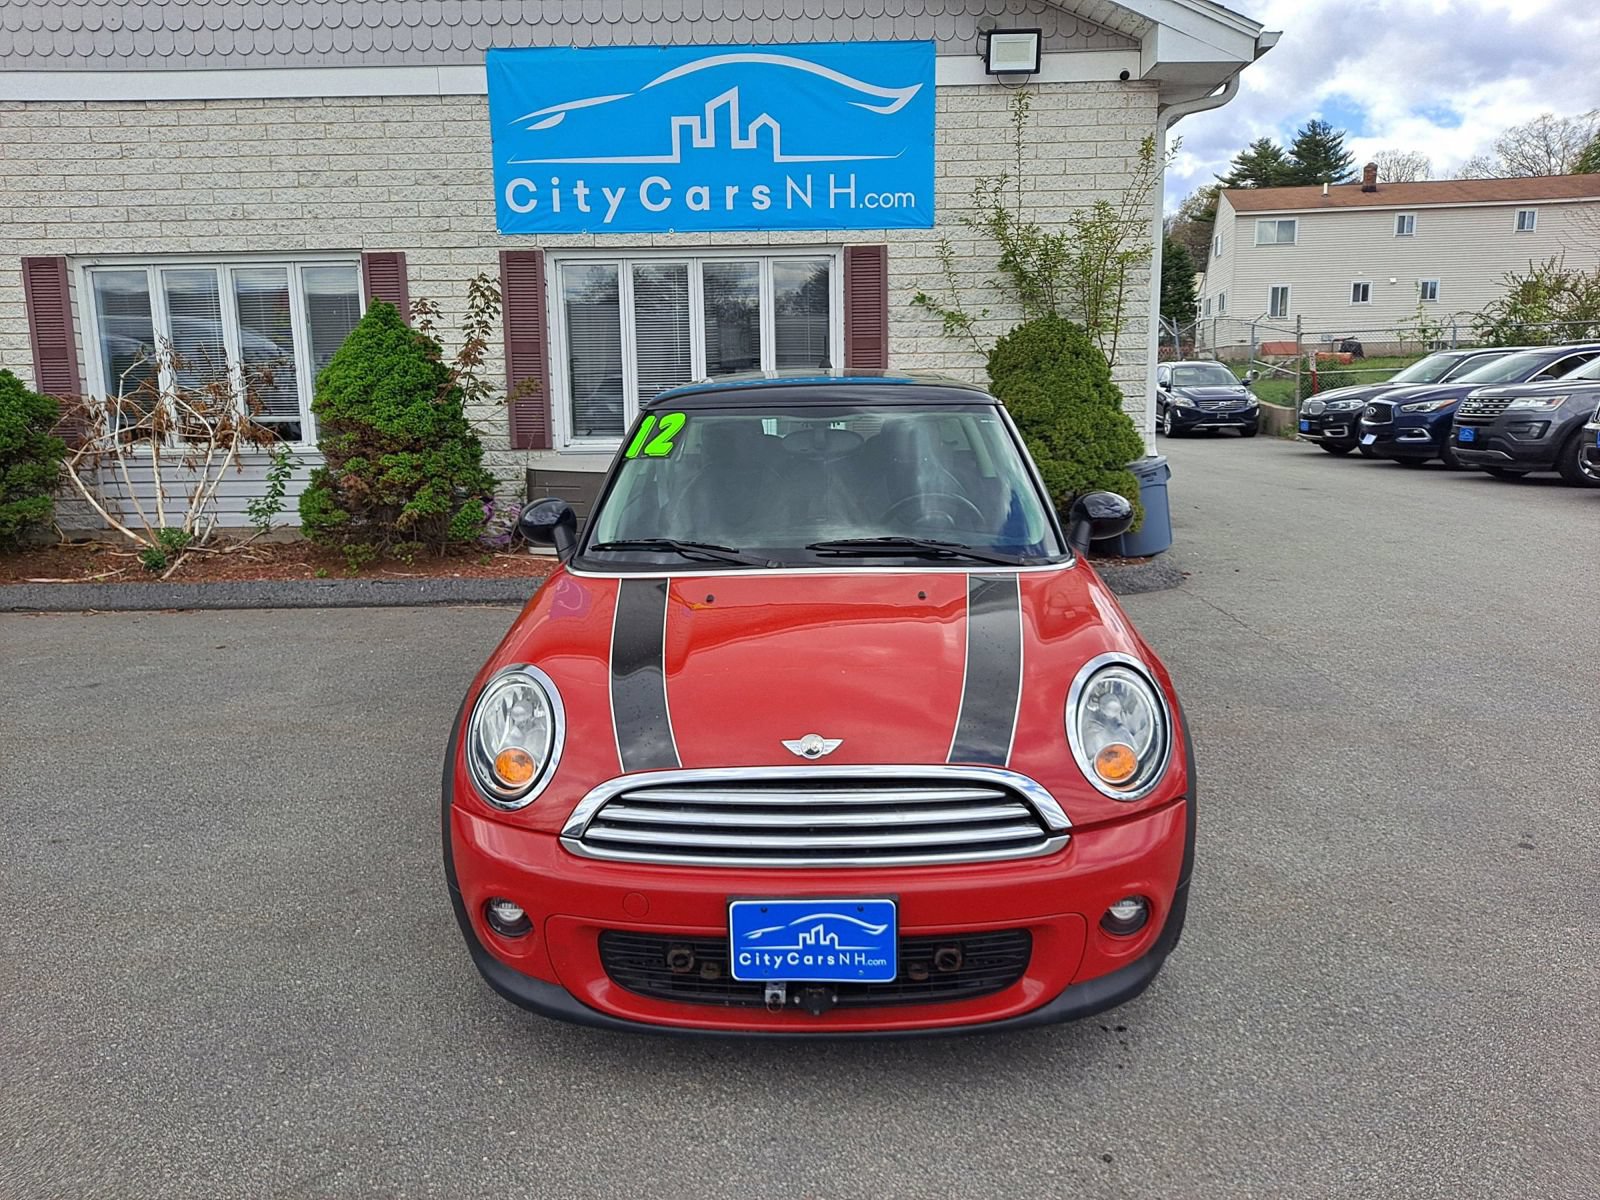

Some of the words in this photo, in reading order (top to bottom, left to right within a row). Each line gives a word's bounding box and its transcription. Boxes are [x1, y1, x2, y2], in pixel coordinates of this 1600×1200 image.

[504, 173, 916, 223] CityCarsNH.com
[625, 412, 687, 459] 12
[739, 952, 887, 969] CityCarsNH.com
